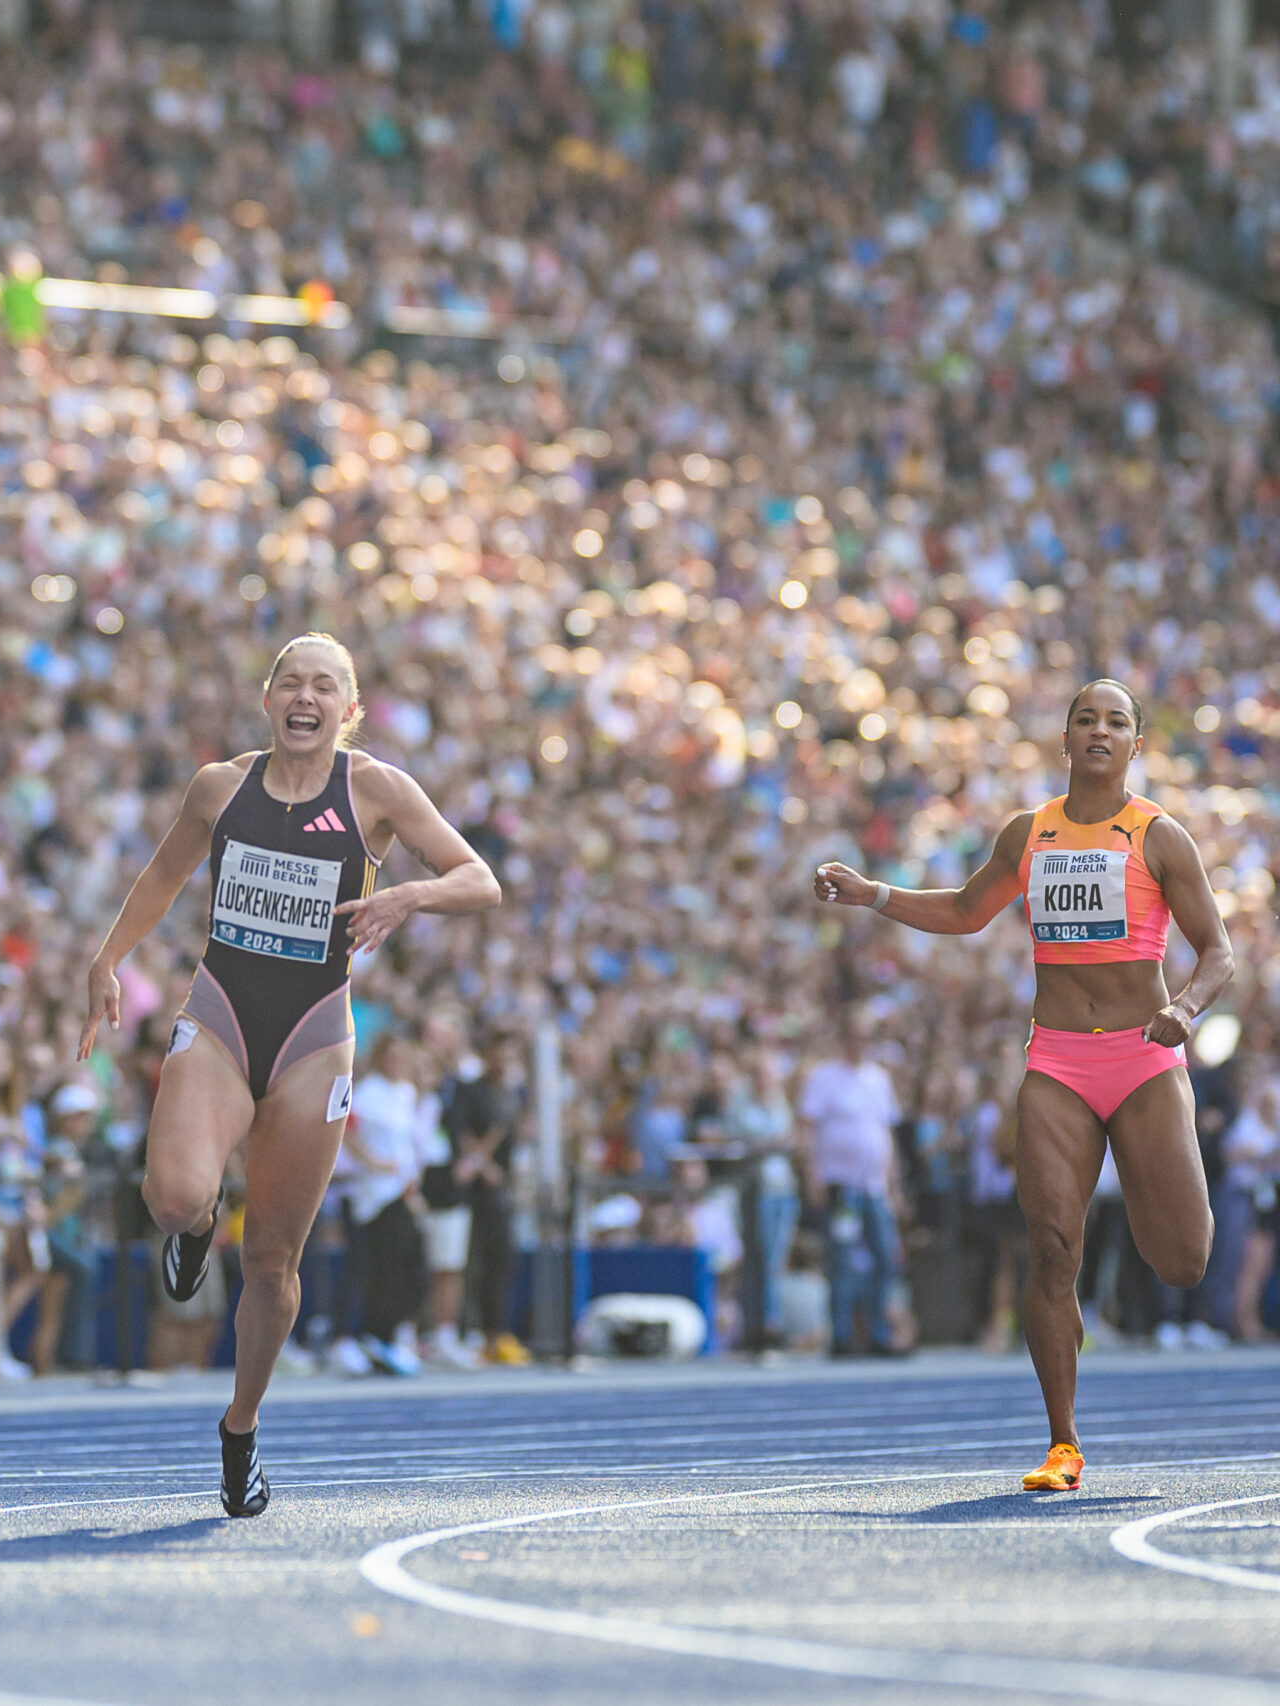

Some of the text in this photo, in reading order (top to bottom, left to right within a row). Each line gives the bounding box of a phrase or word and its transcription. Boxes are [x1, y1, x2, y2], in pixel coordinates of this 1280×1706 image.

[274, 858, 319, 876] MESSE
[1072, 854, 1108, 864] MESSE
[1070, 864, 1106, 873] BERLIN
[273, 870, 317, 887] BERLIN
[217, 875, 331, 930] LÜCKENKEMPER
[1044, 884, 1103, 912] KORA
[1054, 925, 1088, 939] 2024
[243, 931, 283, 953] 2024
